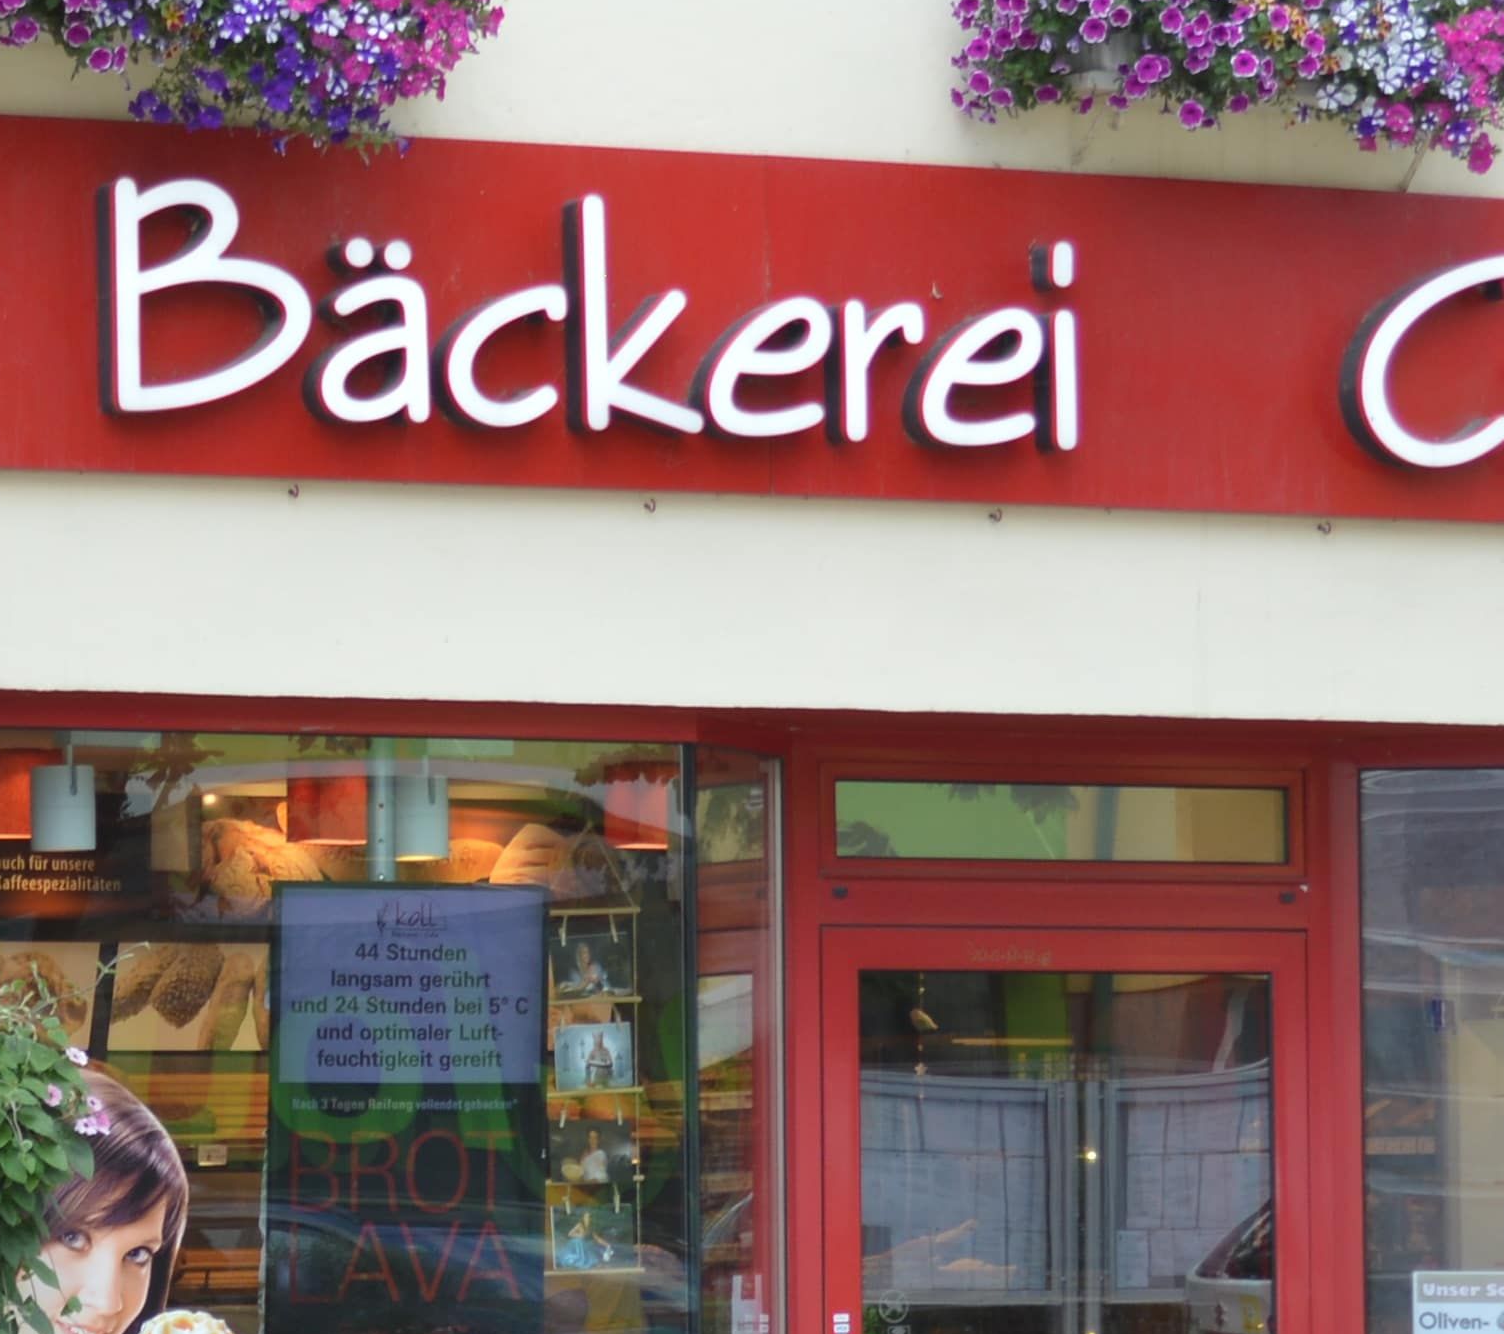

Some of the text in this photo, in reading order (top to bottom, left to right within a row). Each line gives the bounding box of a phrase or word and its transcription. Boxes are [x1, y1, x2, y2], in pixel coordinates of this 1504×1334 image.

[100, 176, 1077, 453] Bäckerei
[29, 854, 49, 871] für
[52, 857, 96, 872] unsere
[355, 943, 467, 962] 44 Stunden
[331, 970, 491, 992] langsam gerührt
[292, 996, 328, 1014] und
[335, 996, 360, 1014] 24
[366, 996, 446, 1015] Stunden
[454, 997, 482, 1015] bei
[515, 997, 529, 1015] C
[316, 1023, 504, 1045] und optimaler Luft-
[317, 1050, 503, 1072] feuchtigkeit gereift
[292, 1098, 319, 1110] Nach
[321, 1098, 329, 1110] 3
[331, 1098, 366, 1112] Tagen
[368, 1098, 413, 1112] Reifung
[415, 1099, 464, 1110] vollendet
[289, 1128, 517, 1214] BROT
[288, 1219, 522, 1304] LAVA
[1421, 1283, 1481, 1297] Unser
[1419, 1311, 1490, 1331] Oliven-
